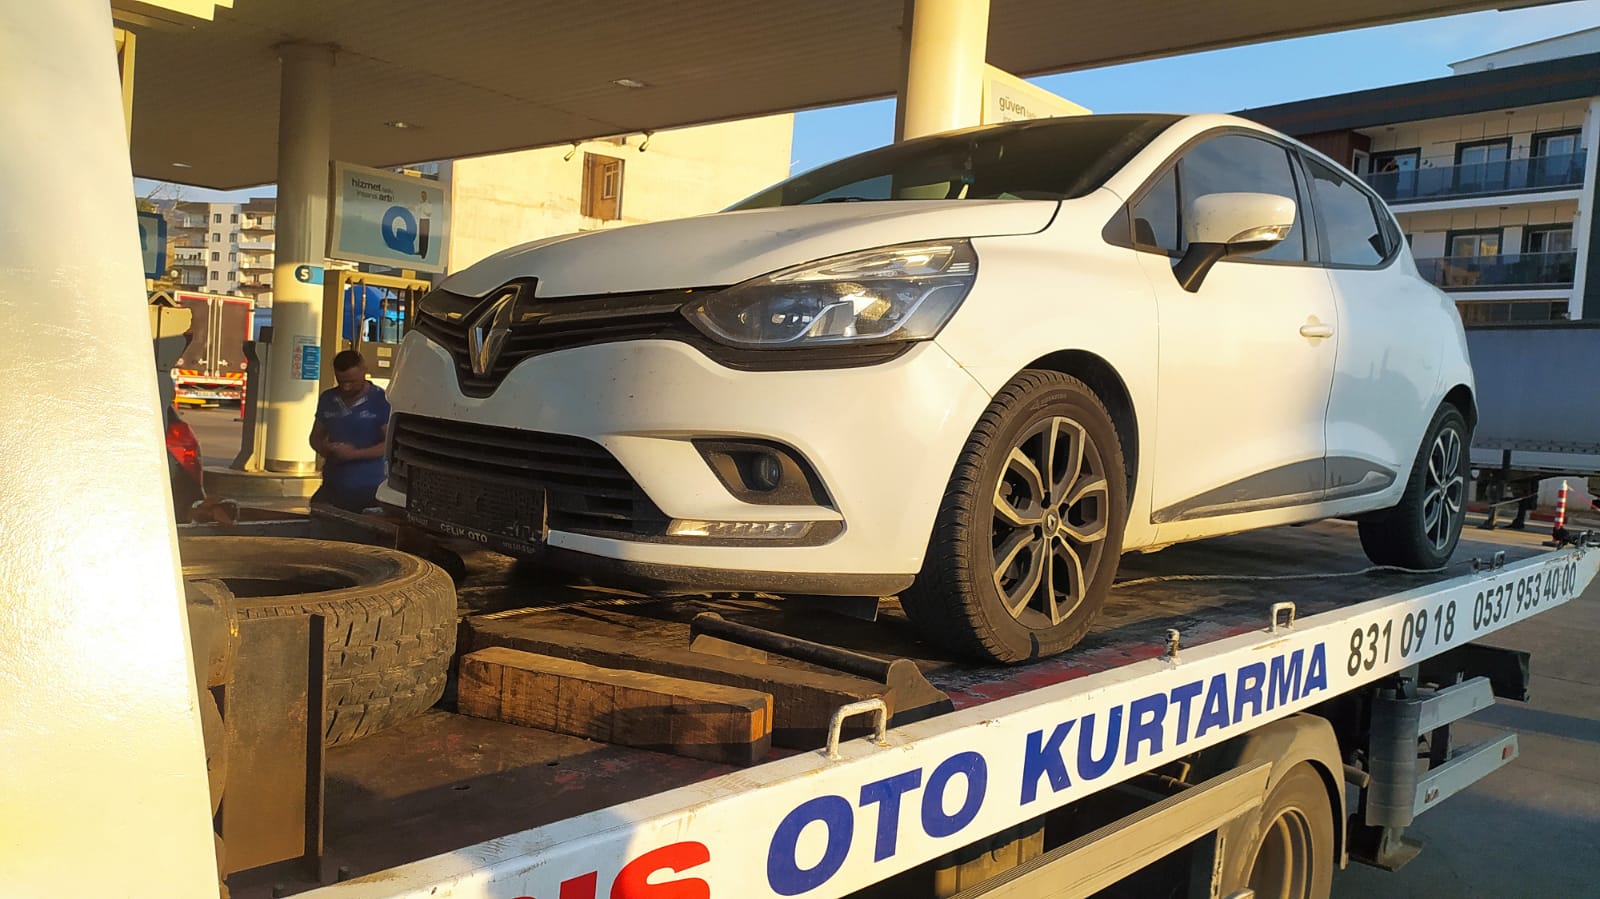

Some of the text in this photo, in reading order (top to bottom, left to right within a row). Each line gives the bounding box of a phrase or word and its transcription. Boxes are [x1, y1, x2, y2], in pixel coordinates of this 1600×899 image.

[468, 530, 488, 543] OTO
[766, 751, 988, 897] OTO
[1020, 642, 1328, 804] KURTARMA
[1347, 619, 1393, 677] 831
[1400, 608, 1428, 658] 09
[1434, 600, 1457, 646] 18
[1472, 582, 1514, 631] 0537
[1516, 573, 1541, 614] 953
[1543, 567, 1560, 599] 40
